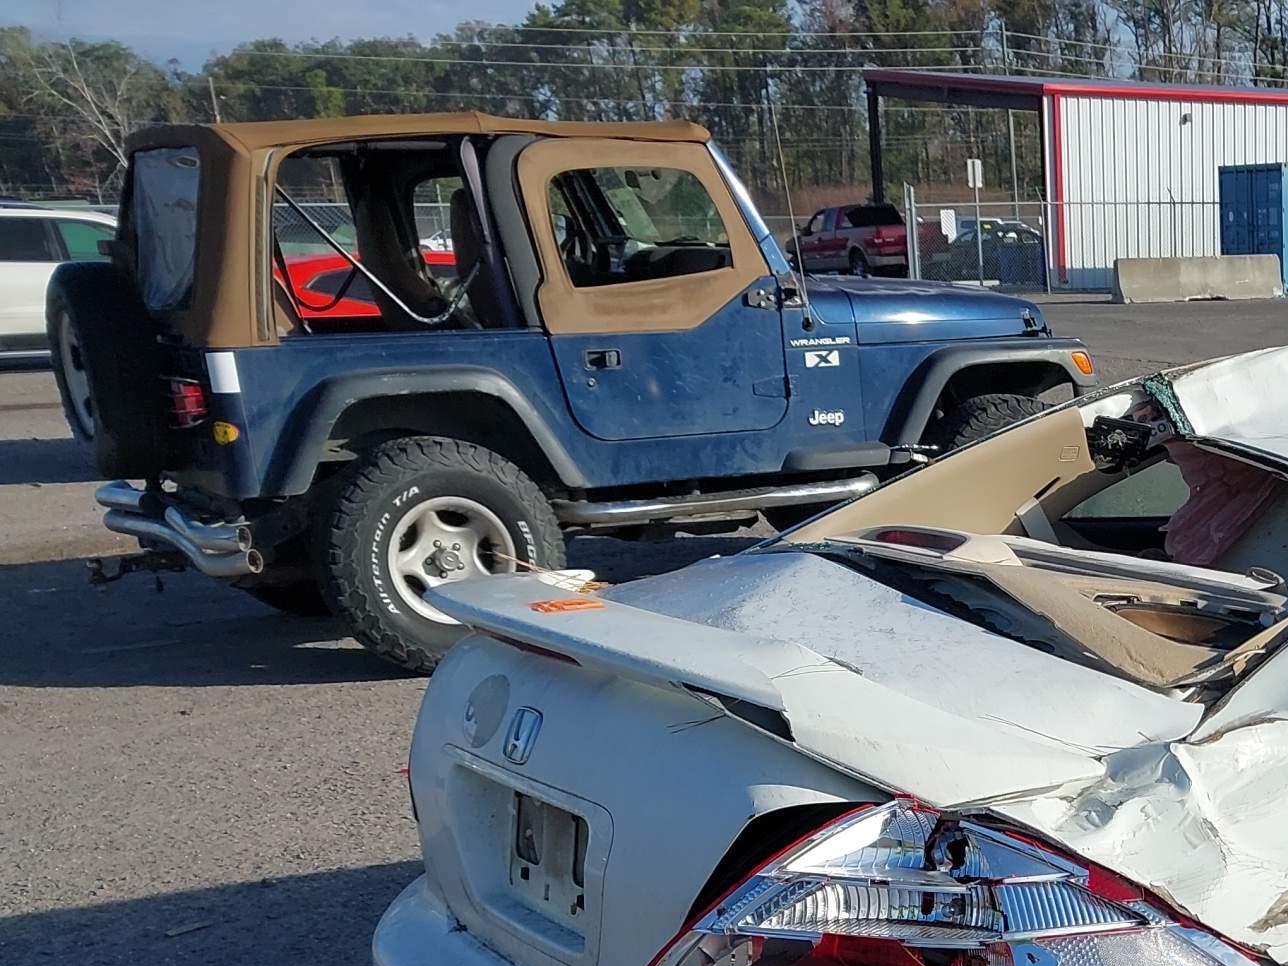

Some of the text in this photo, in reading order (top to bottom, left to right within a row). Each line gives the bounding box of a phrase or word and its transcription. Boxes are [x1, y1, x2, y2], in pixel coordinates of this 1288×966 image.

[790, 337, 850, 346] WRANGLER
[809, 409, 845, 426] Jeep
[392, 485, 420, 507] T/A
